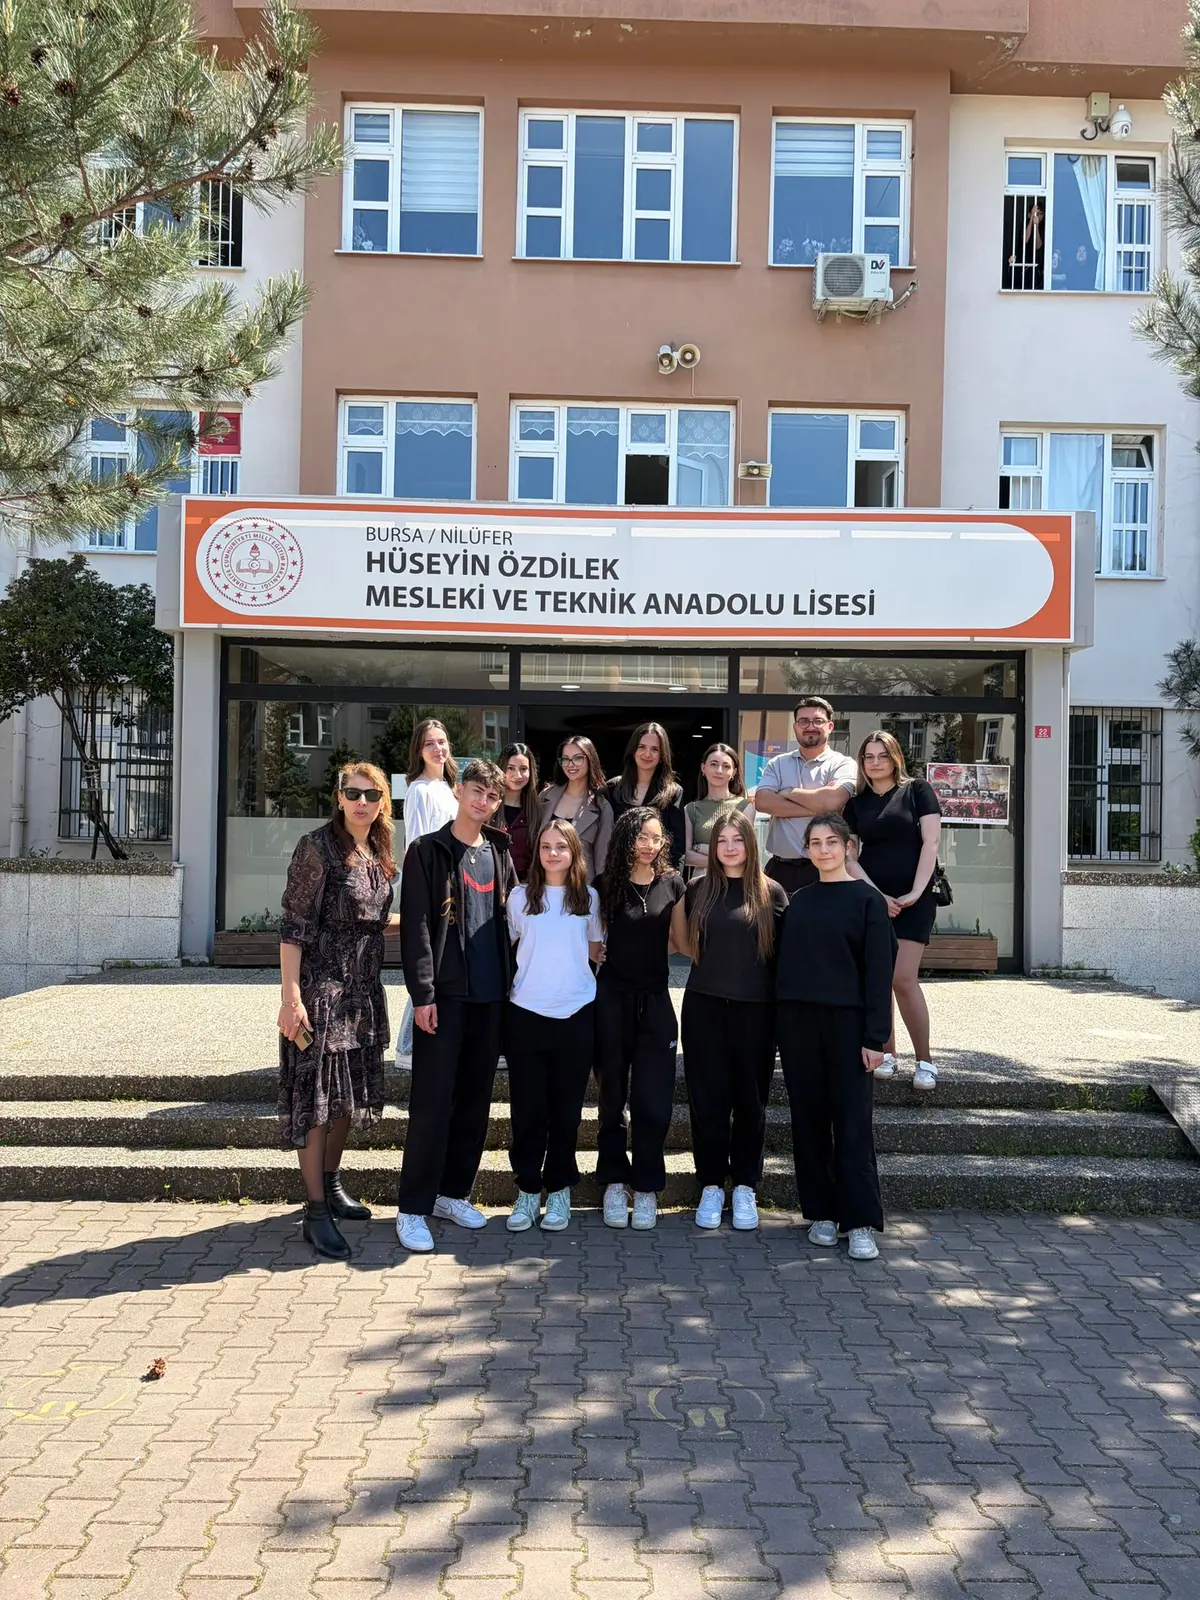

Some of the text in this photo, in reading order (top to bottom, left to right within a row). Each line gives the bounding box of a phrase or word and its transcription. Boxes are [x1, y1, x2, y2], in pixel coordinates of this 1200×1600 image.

[366, 526, 513, 546] BURSA / NİLÜFER
[366, 546, 620, 581] HÜSEYİN ÖZDİLEK
[365, 583, 875, 616] MESLEKİ VE TEKNİK ANADOLU LİSESİ
[939, 789, 1000, 799] 18 MART
